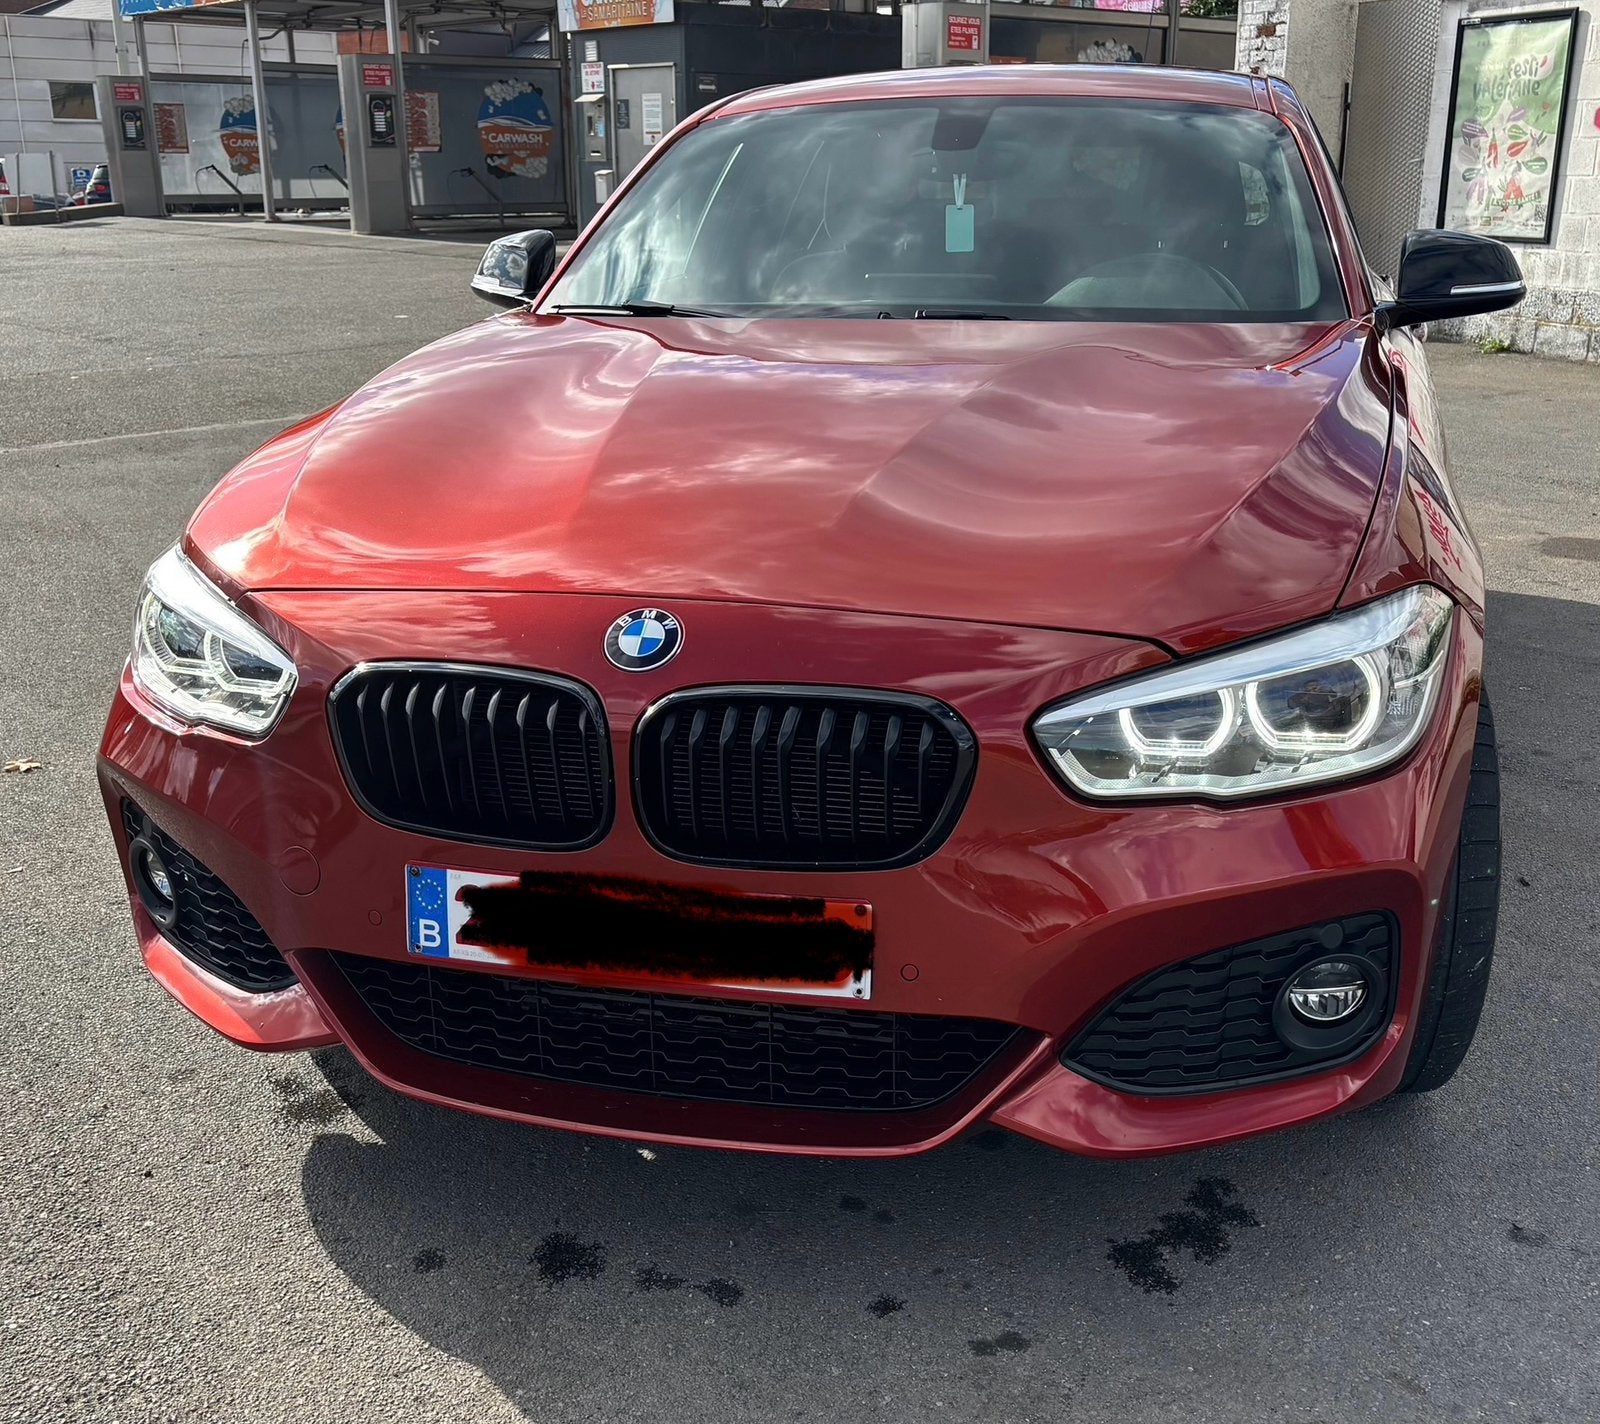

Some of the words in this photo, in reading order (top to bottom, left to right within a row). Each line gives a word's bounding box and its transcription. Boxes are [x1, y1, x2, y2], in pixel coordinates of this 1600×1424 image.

[587, 1, 648, 21] SAMARITAINE
[230, 138, 258, 147] CARW
[488, 133, 543, 143] CARWASH
[617, 610, 677, 630] BMW
[419, 918, 441, 947] B
